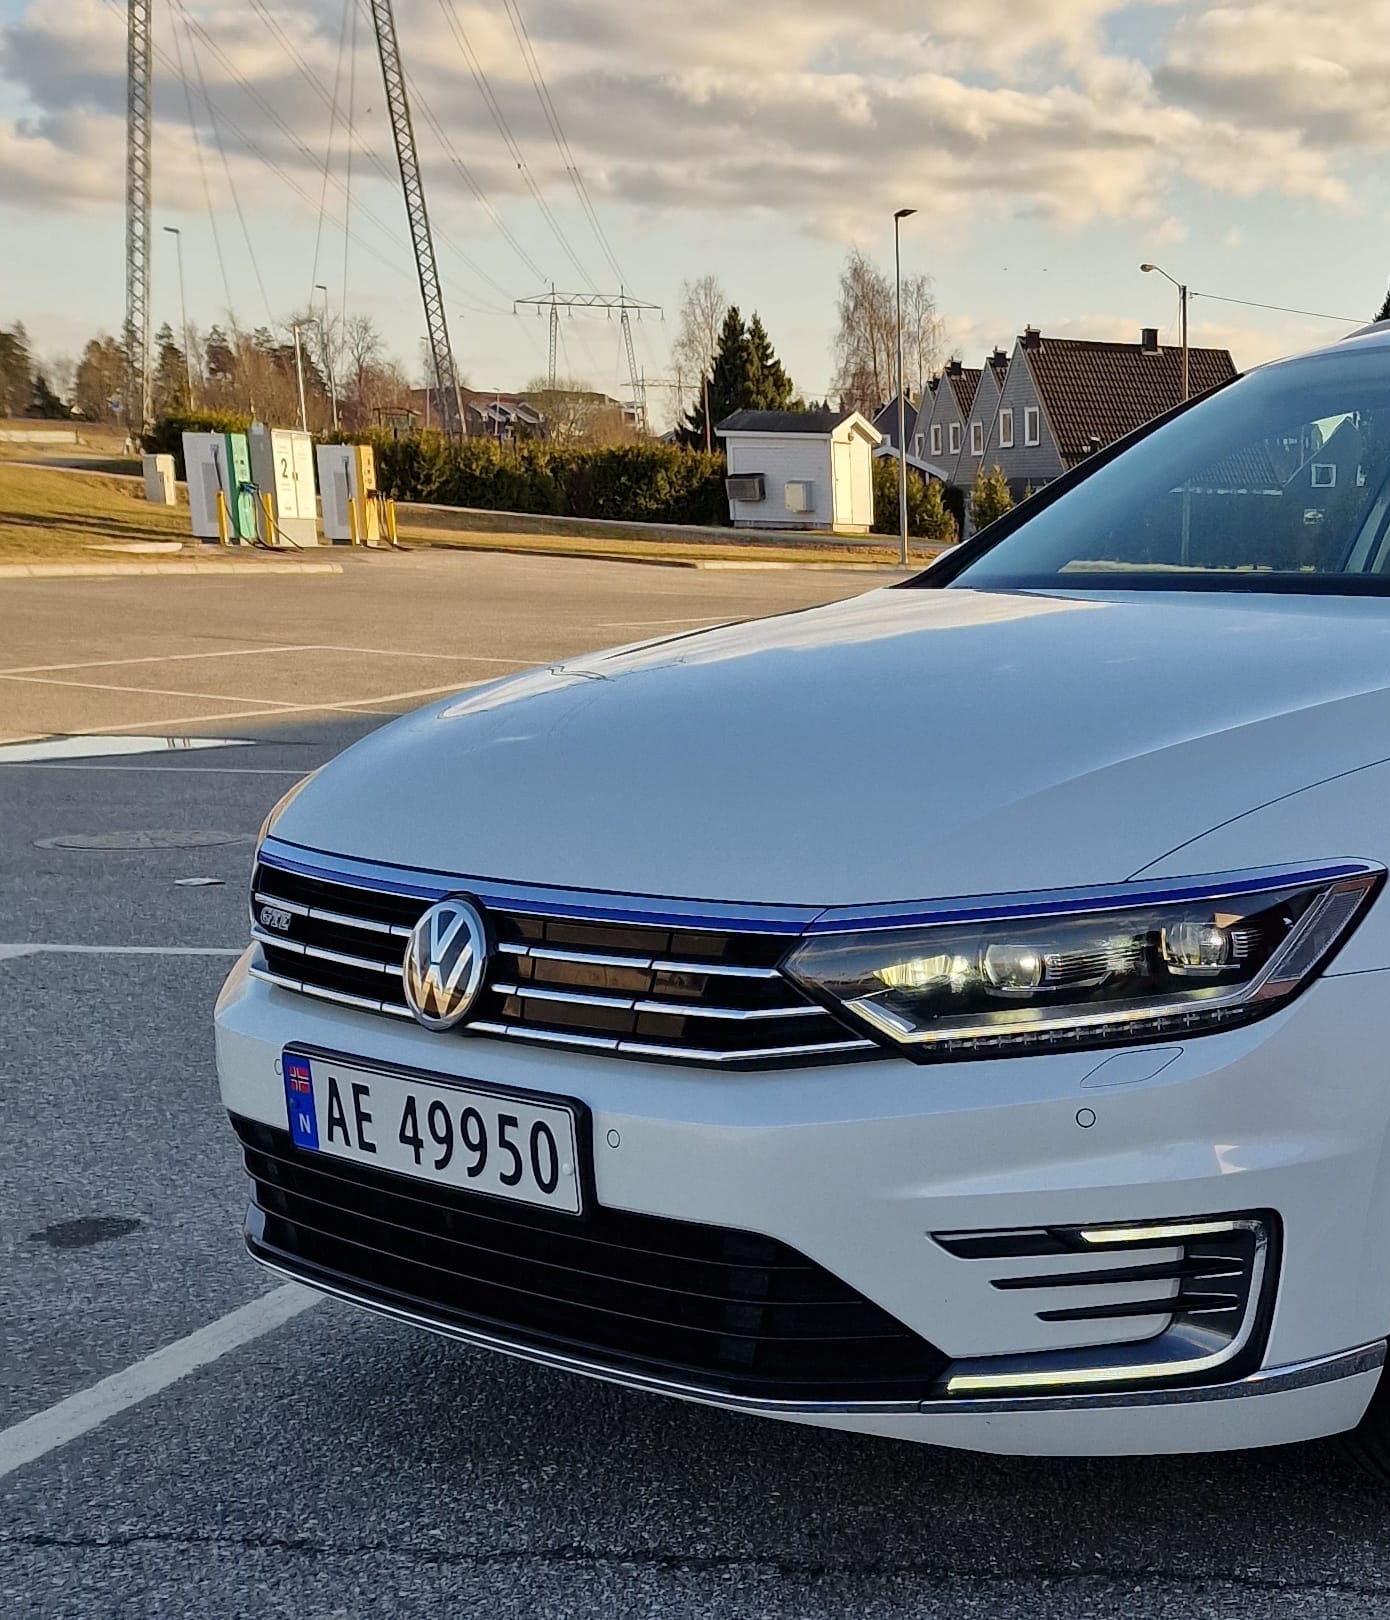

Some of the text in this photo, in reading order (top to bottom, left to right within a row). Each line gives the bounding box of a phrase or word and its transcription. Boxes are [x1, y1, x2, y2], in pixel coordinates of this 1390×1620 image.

[281, 457, 289, 479] 2
[298, 1112, 311, 1134] N
[327, 1076, 559, 1194] AE 49950
